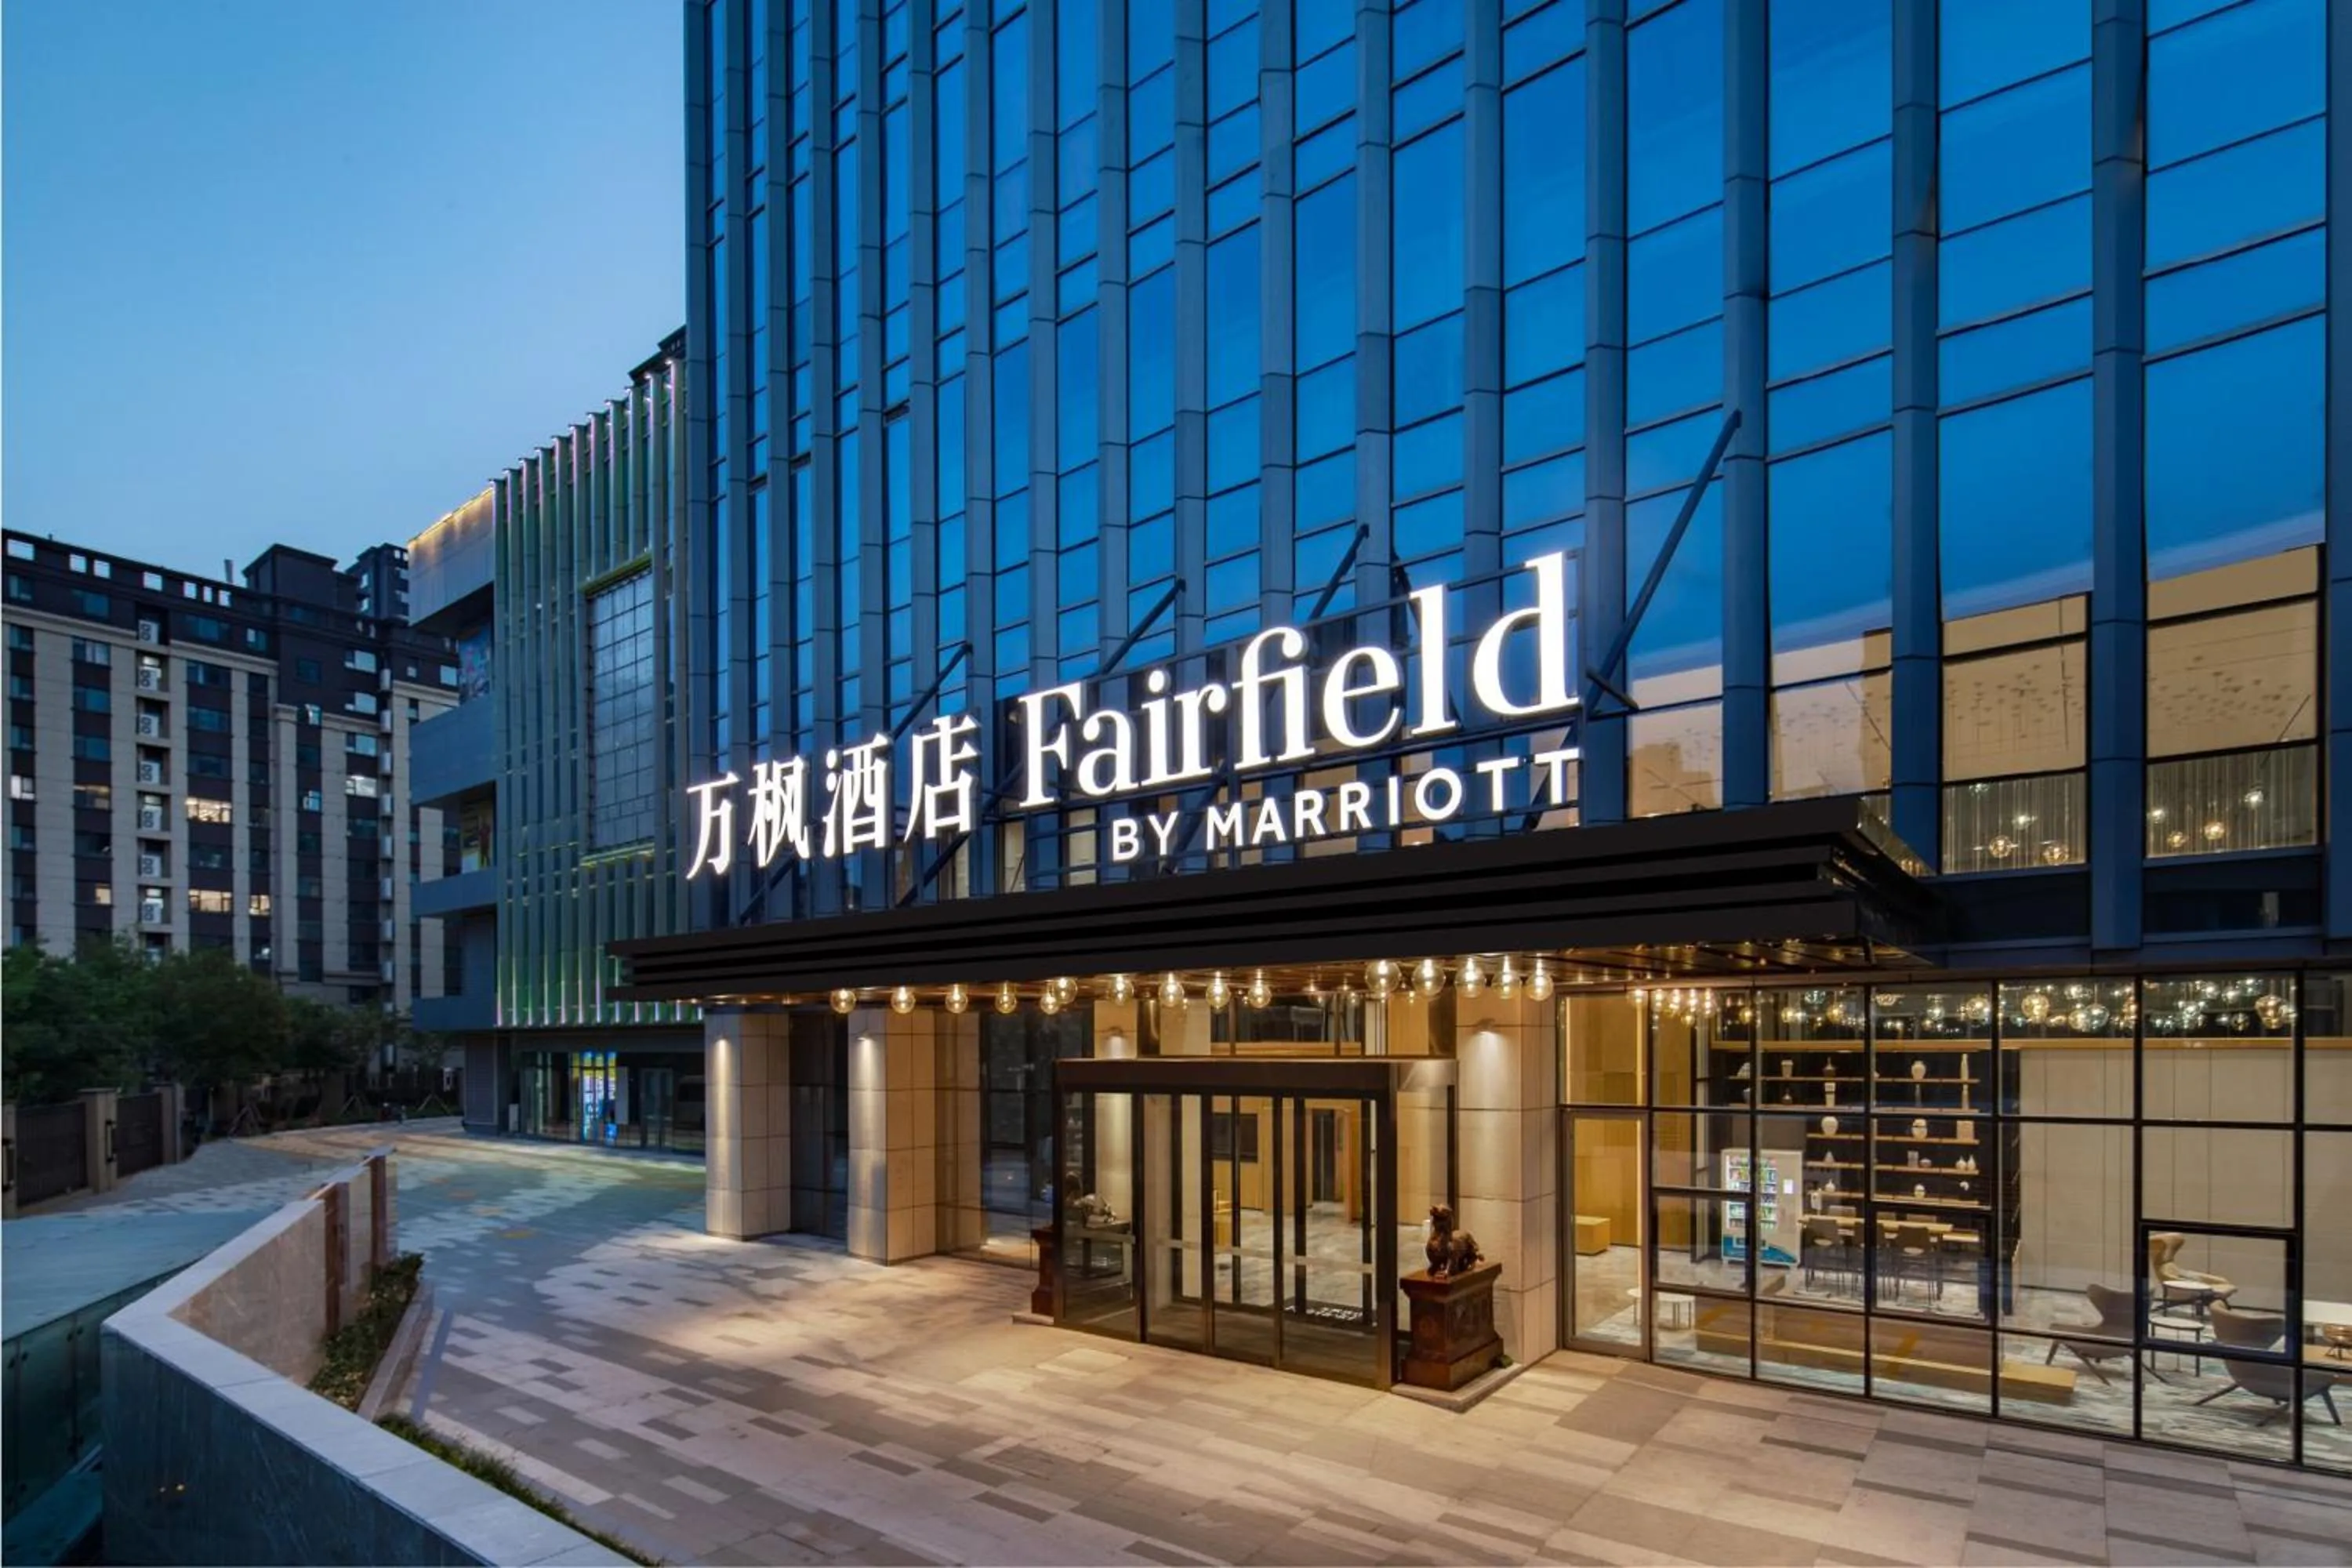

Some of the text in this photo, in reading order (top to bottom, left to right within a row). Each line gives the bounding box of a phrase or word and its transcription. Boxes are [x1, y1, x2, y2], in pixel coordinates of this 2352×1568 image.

[1018, 551, 1581, 808] Fairfield
[686, 714, 979, 880] 万枫酒店
[1112, 747, 1580, 862] BY MARRIOTT
